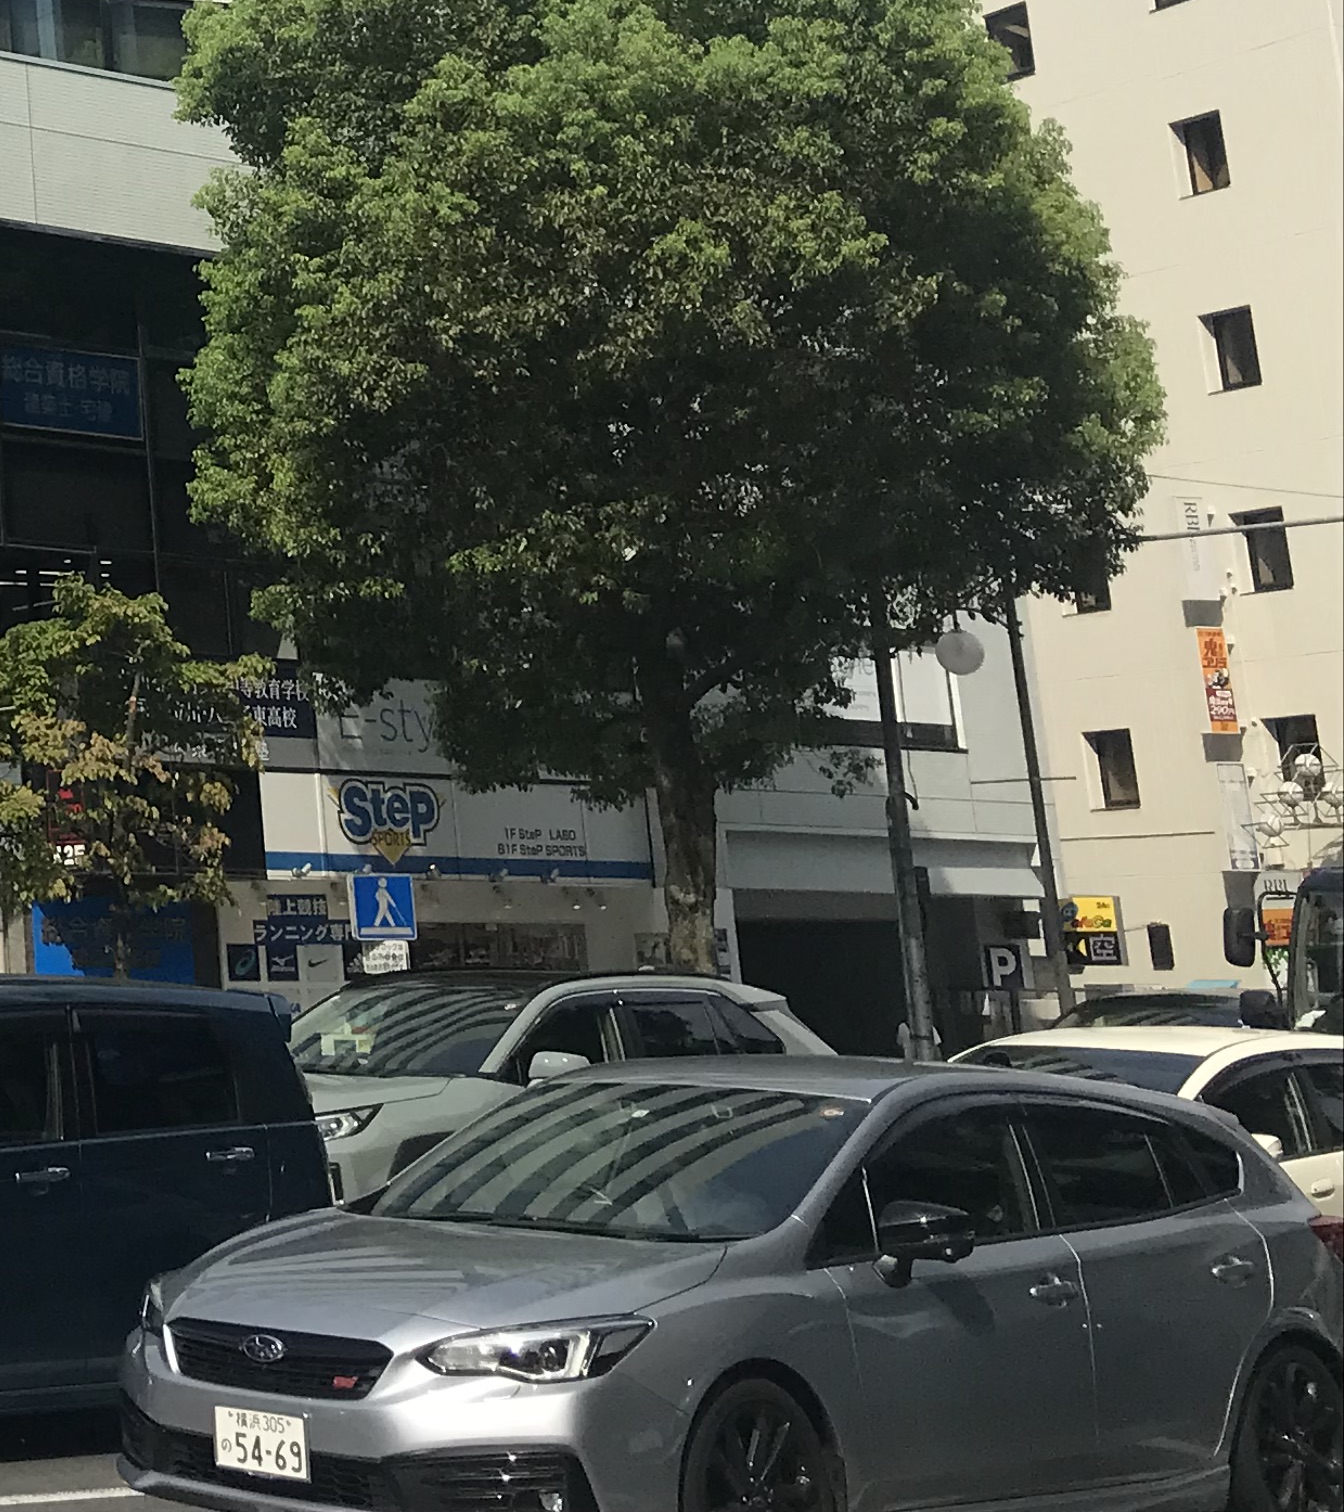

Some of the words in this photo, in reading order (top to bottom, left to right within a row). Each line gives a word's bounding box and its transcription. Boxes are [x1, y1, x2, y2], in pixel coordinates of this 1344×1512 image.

[373, 830, 411, 846] SPORTS
[545, 845, 587, 857] SPORTS
[235, 1432, 302, 1473] 54-69
